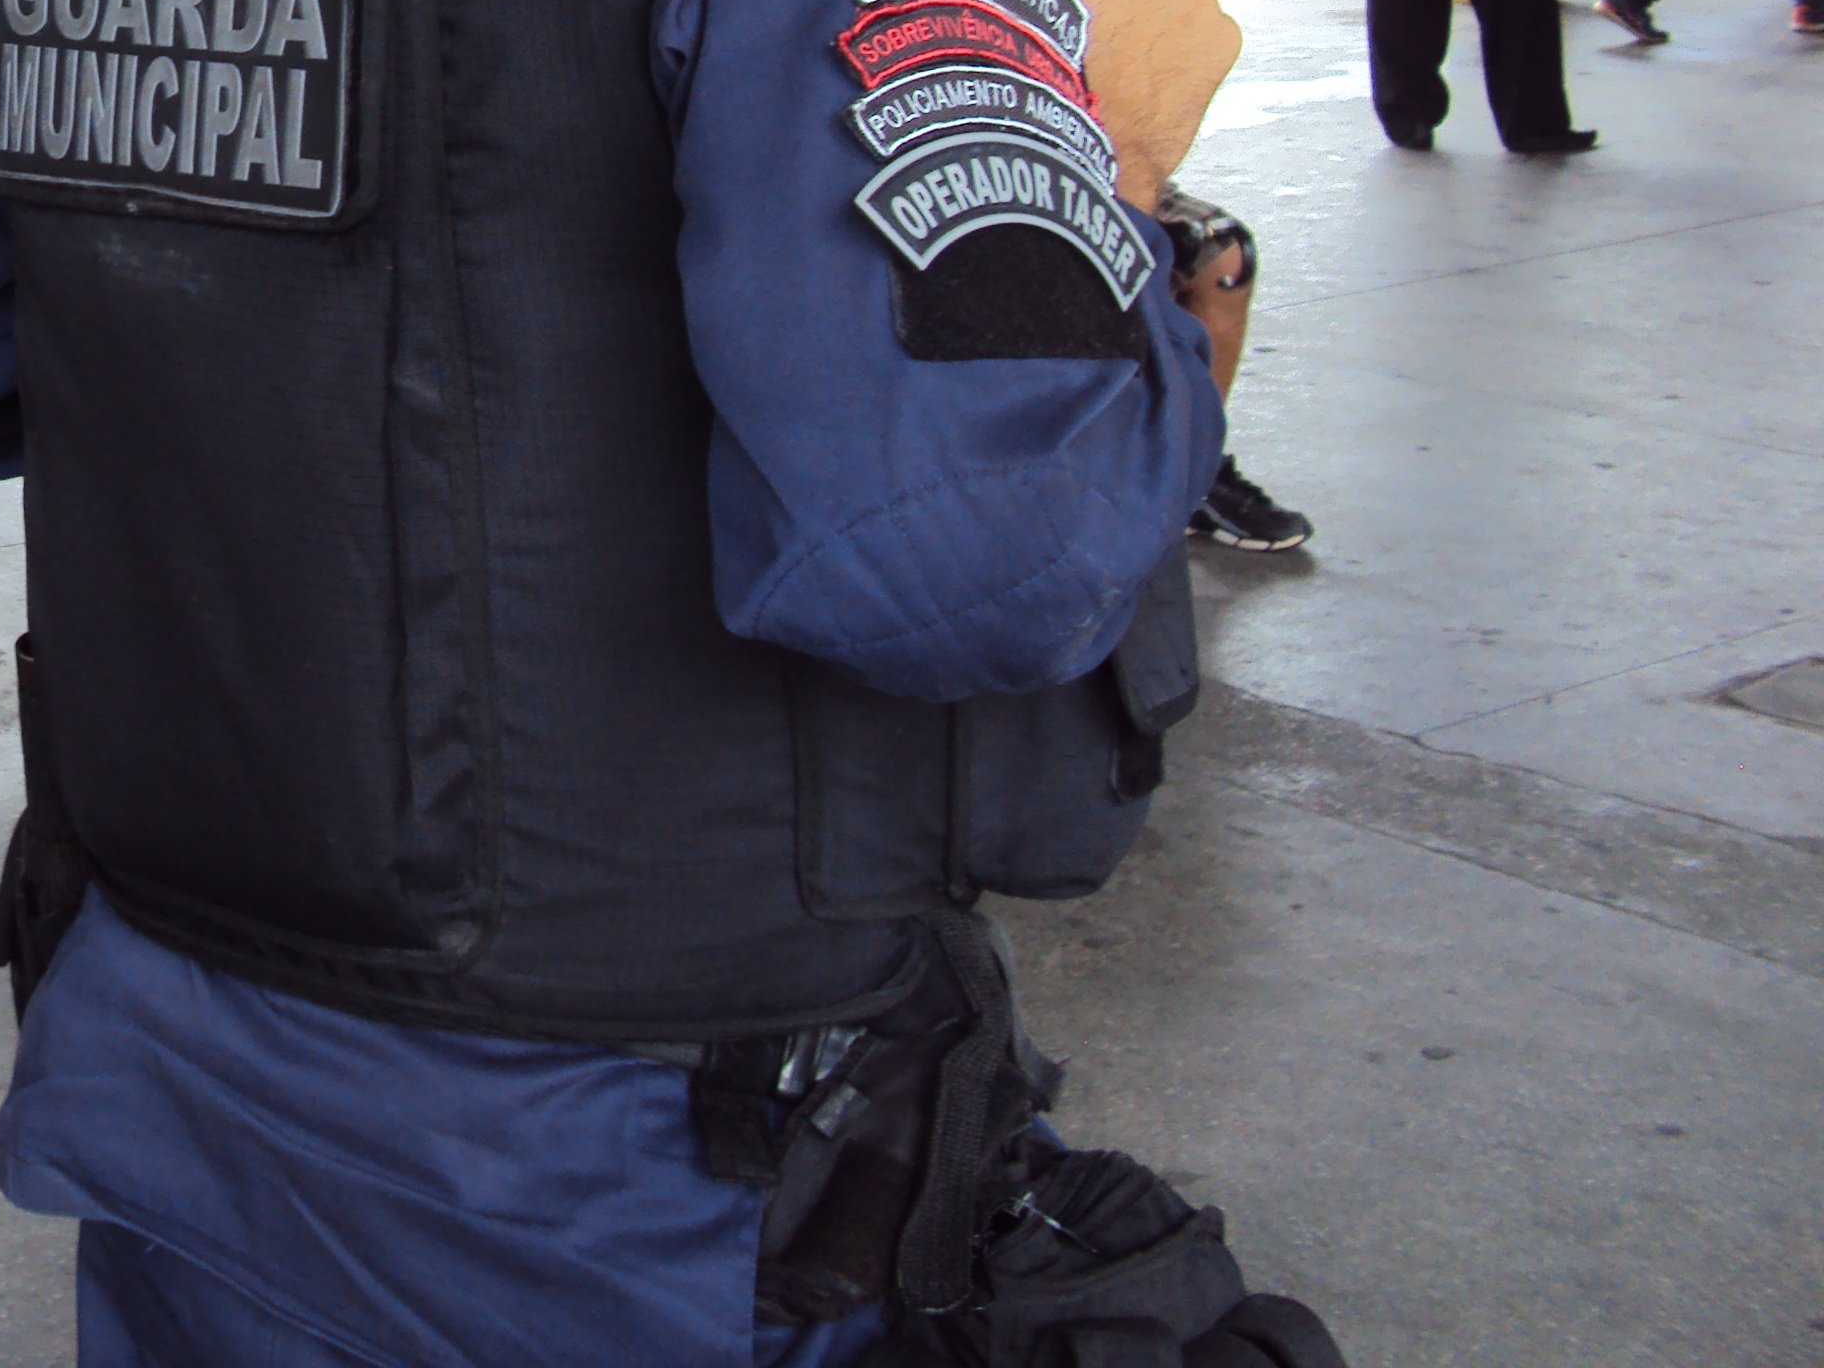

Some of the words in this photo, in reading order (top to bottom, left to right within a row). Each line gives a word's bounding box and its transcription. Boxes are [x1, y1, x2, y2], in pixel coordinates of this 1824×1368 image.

[857, 8, 1019, 65] SOBREVIVÊNCIA
[867, 78, 1018, 140] POLICIAMENTO
[1025, 91, 1110, 179] AMBIENTAL
[889, 155, 1055, 240] OPERADOR
[1059, 174, 1137, 283] TASER
